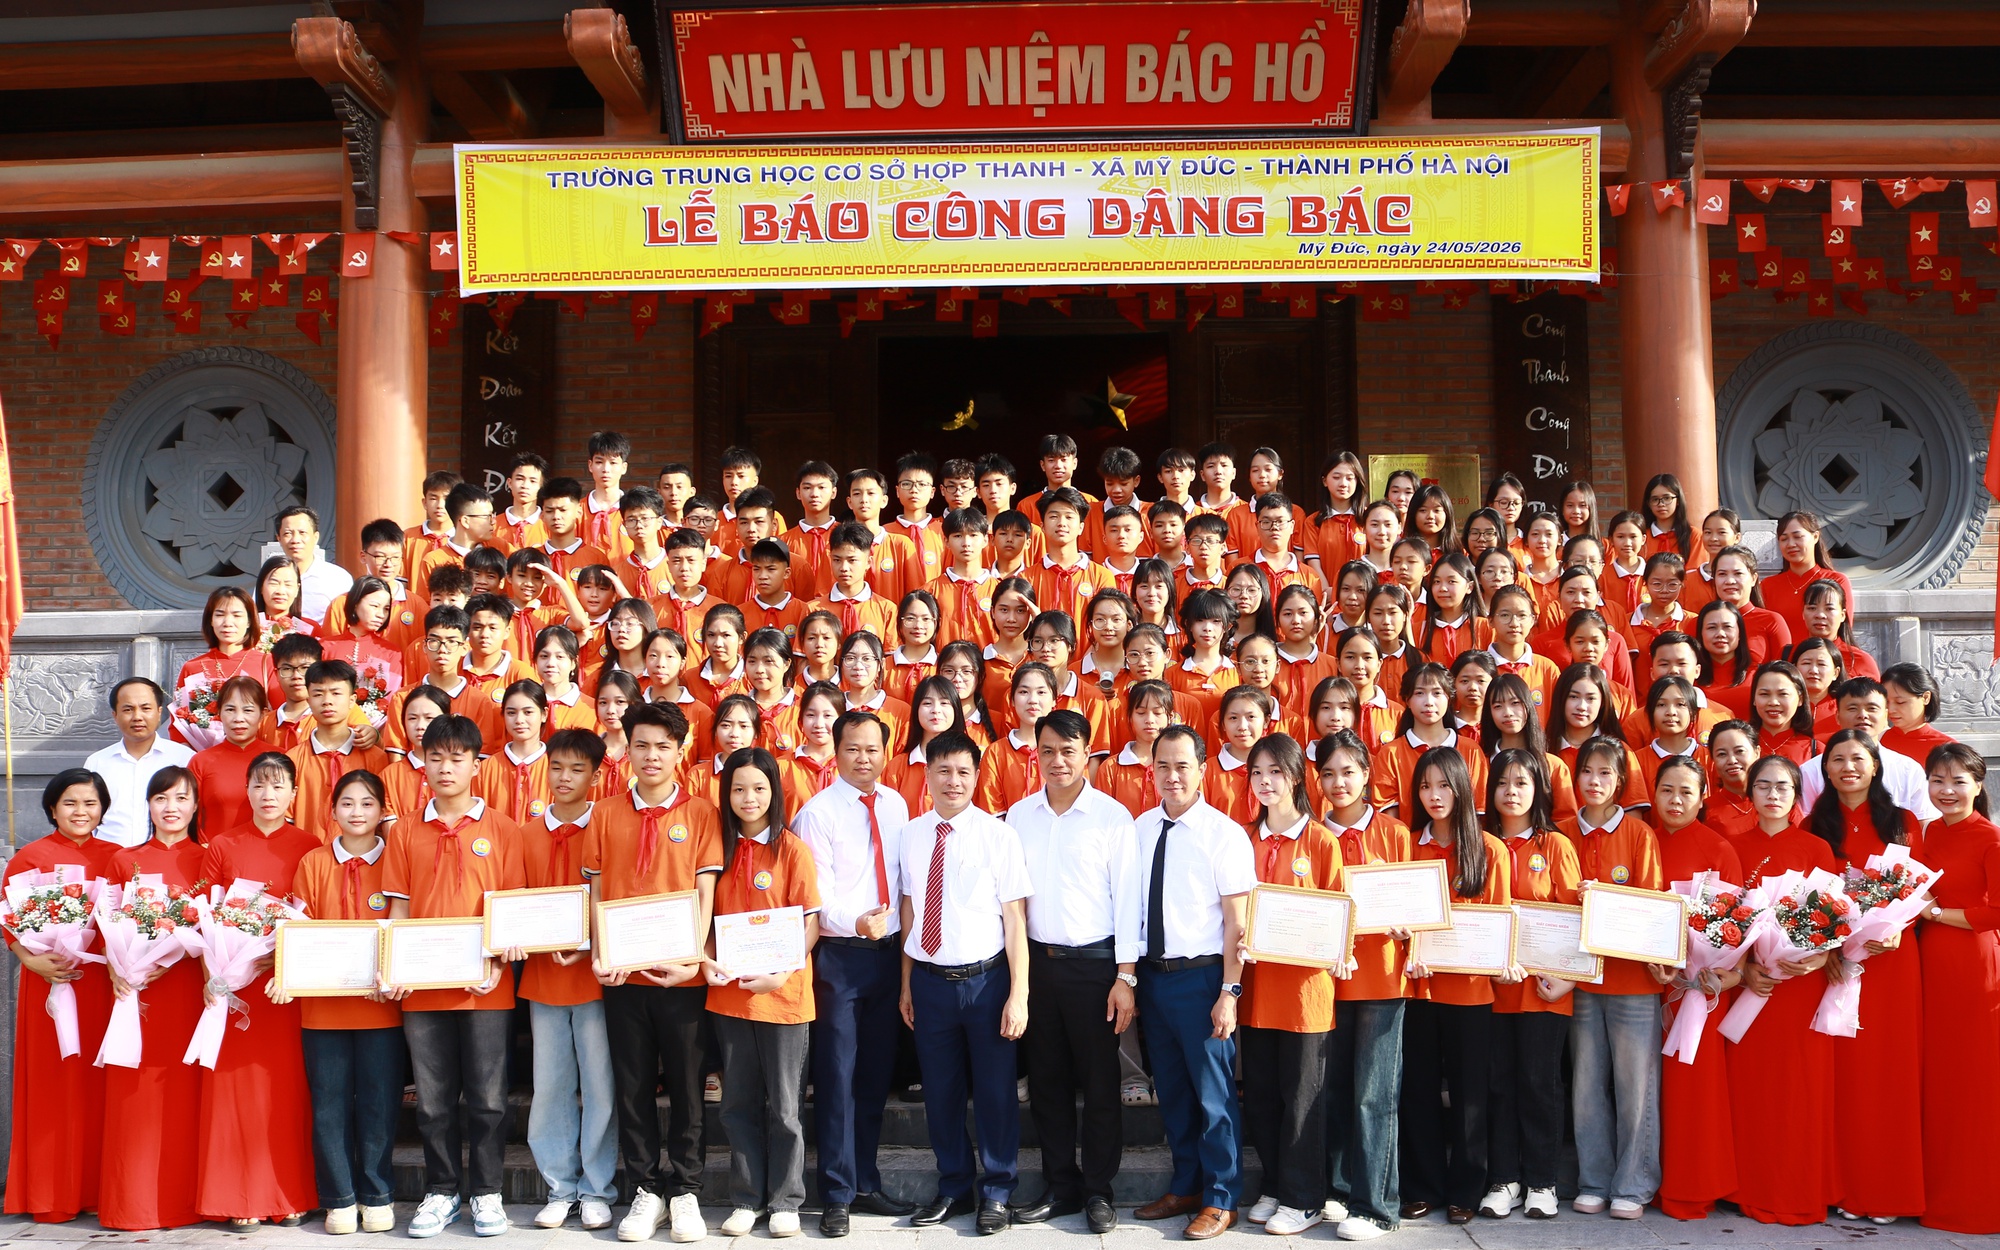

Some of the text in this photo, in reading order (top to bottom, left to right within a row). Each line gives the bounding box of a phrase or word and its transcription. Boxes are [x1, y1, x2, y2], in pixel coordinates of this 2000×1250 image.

[708, 19, 1327, 118] NHÀ LƯU NIỆM BÁC HỒ
[547, 166, 653, 188] TRƯỜNG
[662, 166, 751, 186] TRUNG
[761, 165, 815, 187] HỌC
[824, 162, 861, 182] CƠ
[869, 158, 905, 182] SỞ
[913, 161, 967, 182] HỢP
[976, 161, 1065, 178] THANH
[1091, 157, 1126, 177] XÃ
[1134, 156, 1172, 177] MỸ
[1181, 156, 1235, 176] ĐỨC
[1261, 155, 1350, 175] THÀNH
[1360, 151, 1415, 175] PHỐ
[1422, 154, 1457, 174] HÀ
[1466, 153, 1509, 178] NỘI
[643, 185, 1412, 246] LỄ BÁO CÔNG DÂNG BÁC
[1298, 242, 1521, 256] Mỹ Đức, ngày 24/05/2026
[1522, 313, 1567, 356] Công
[1522, 358, 1569, 384] Thành
[479, 376, 524, 400] Đoàn
[485, 422, 518, 448] Kết
[1525, 407, 1570, 449] Công
[1532, 454, 1569, 480] Đại
